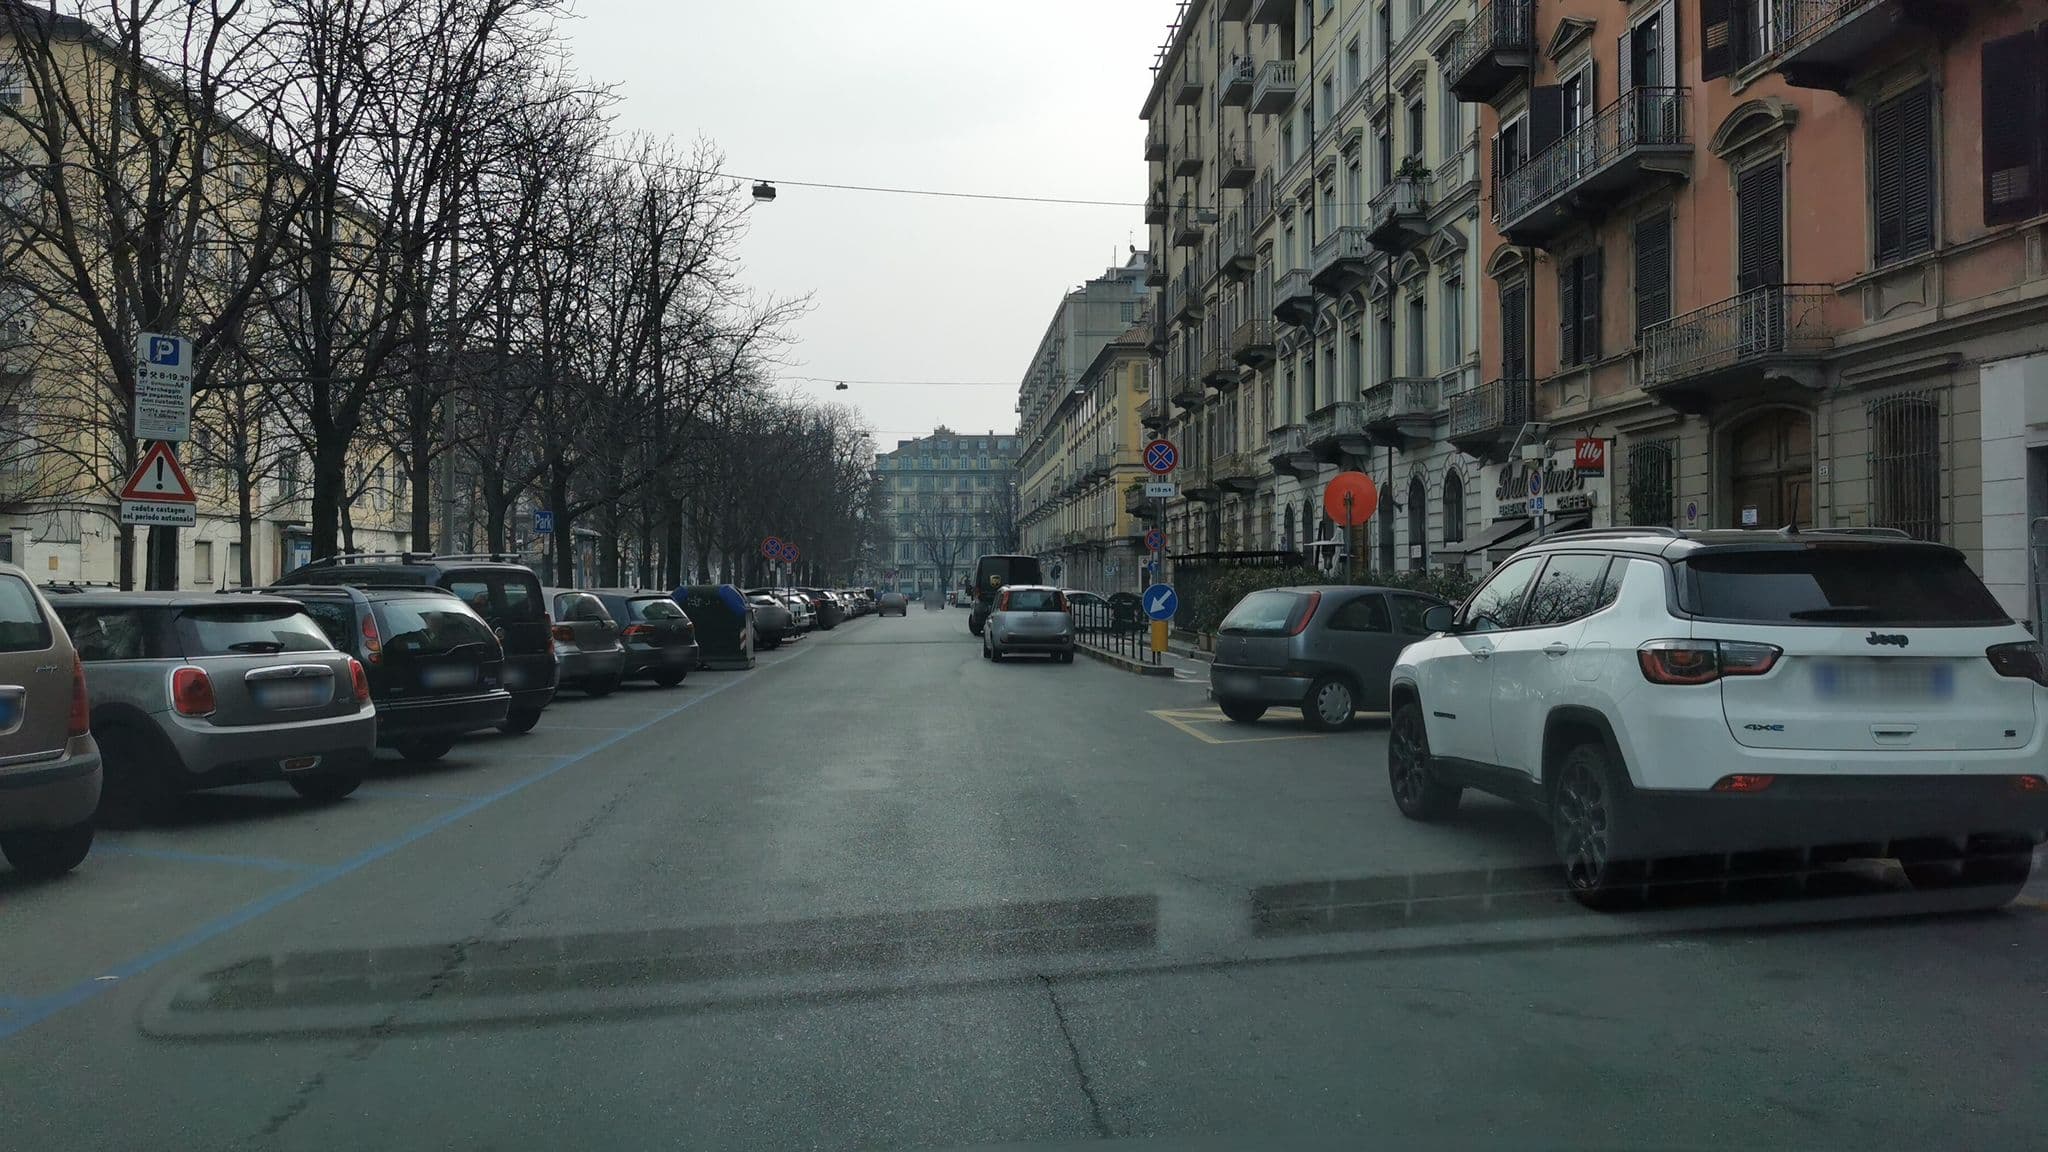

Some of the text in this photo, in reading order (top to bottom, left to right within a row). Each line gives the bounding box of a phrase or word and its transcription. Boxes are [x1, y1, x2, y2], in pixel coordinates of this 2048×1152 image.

[1579, 442, 1602, 462] illy
[131, 505, 186, 515] cadute castagne
[1499, 502, 1527, 516] BREAK
[123, 512, 194, 522] nel periodo autunnale
[535, 513, 552, 530] Park
[1866, 631, 1909, 648] Jeep
